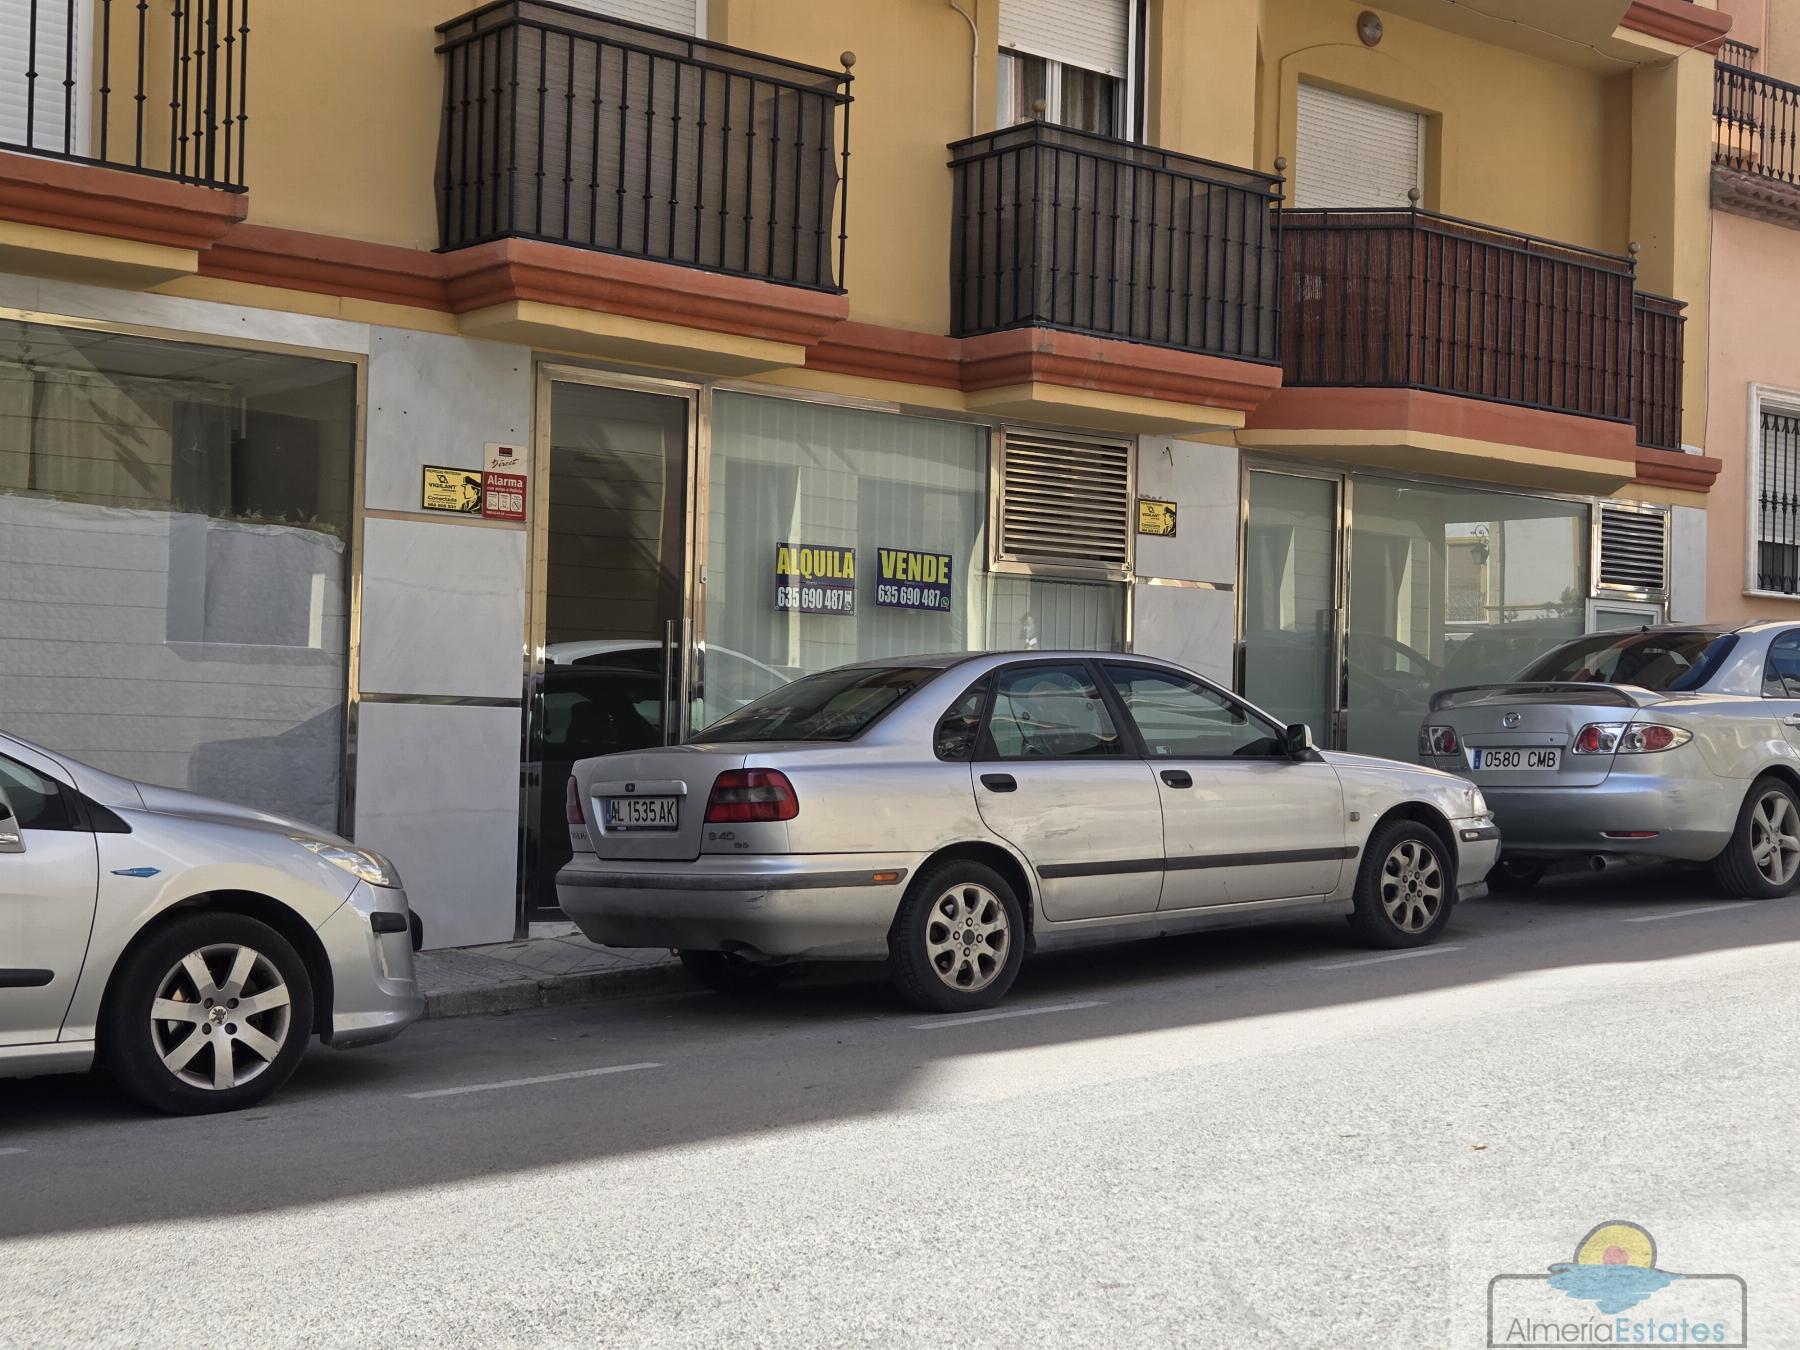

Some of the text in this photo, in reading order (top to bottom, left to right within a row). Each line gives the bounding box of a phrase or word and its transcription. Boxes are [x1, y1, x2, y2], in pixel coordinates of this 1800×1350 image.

[428, 482, 456, 490] VIGILANT
[487, 475, 523, 488] Alarma
[777, 547, 855, 579] ALQUILA
[879, 549, 950, 584] VENDE
[777, 586, 844, 610] 635 690 487
[877, 584, 941, 608] 635 690 487
[1485, 751, 1557, 768] 0580 CMB
[611, 800, 675, 823] AL 1535 AK
